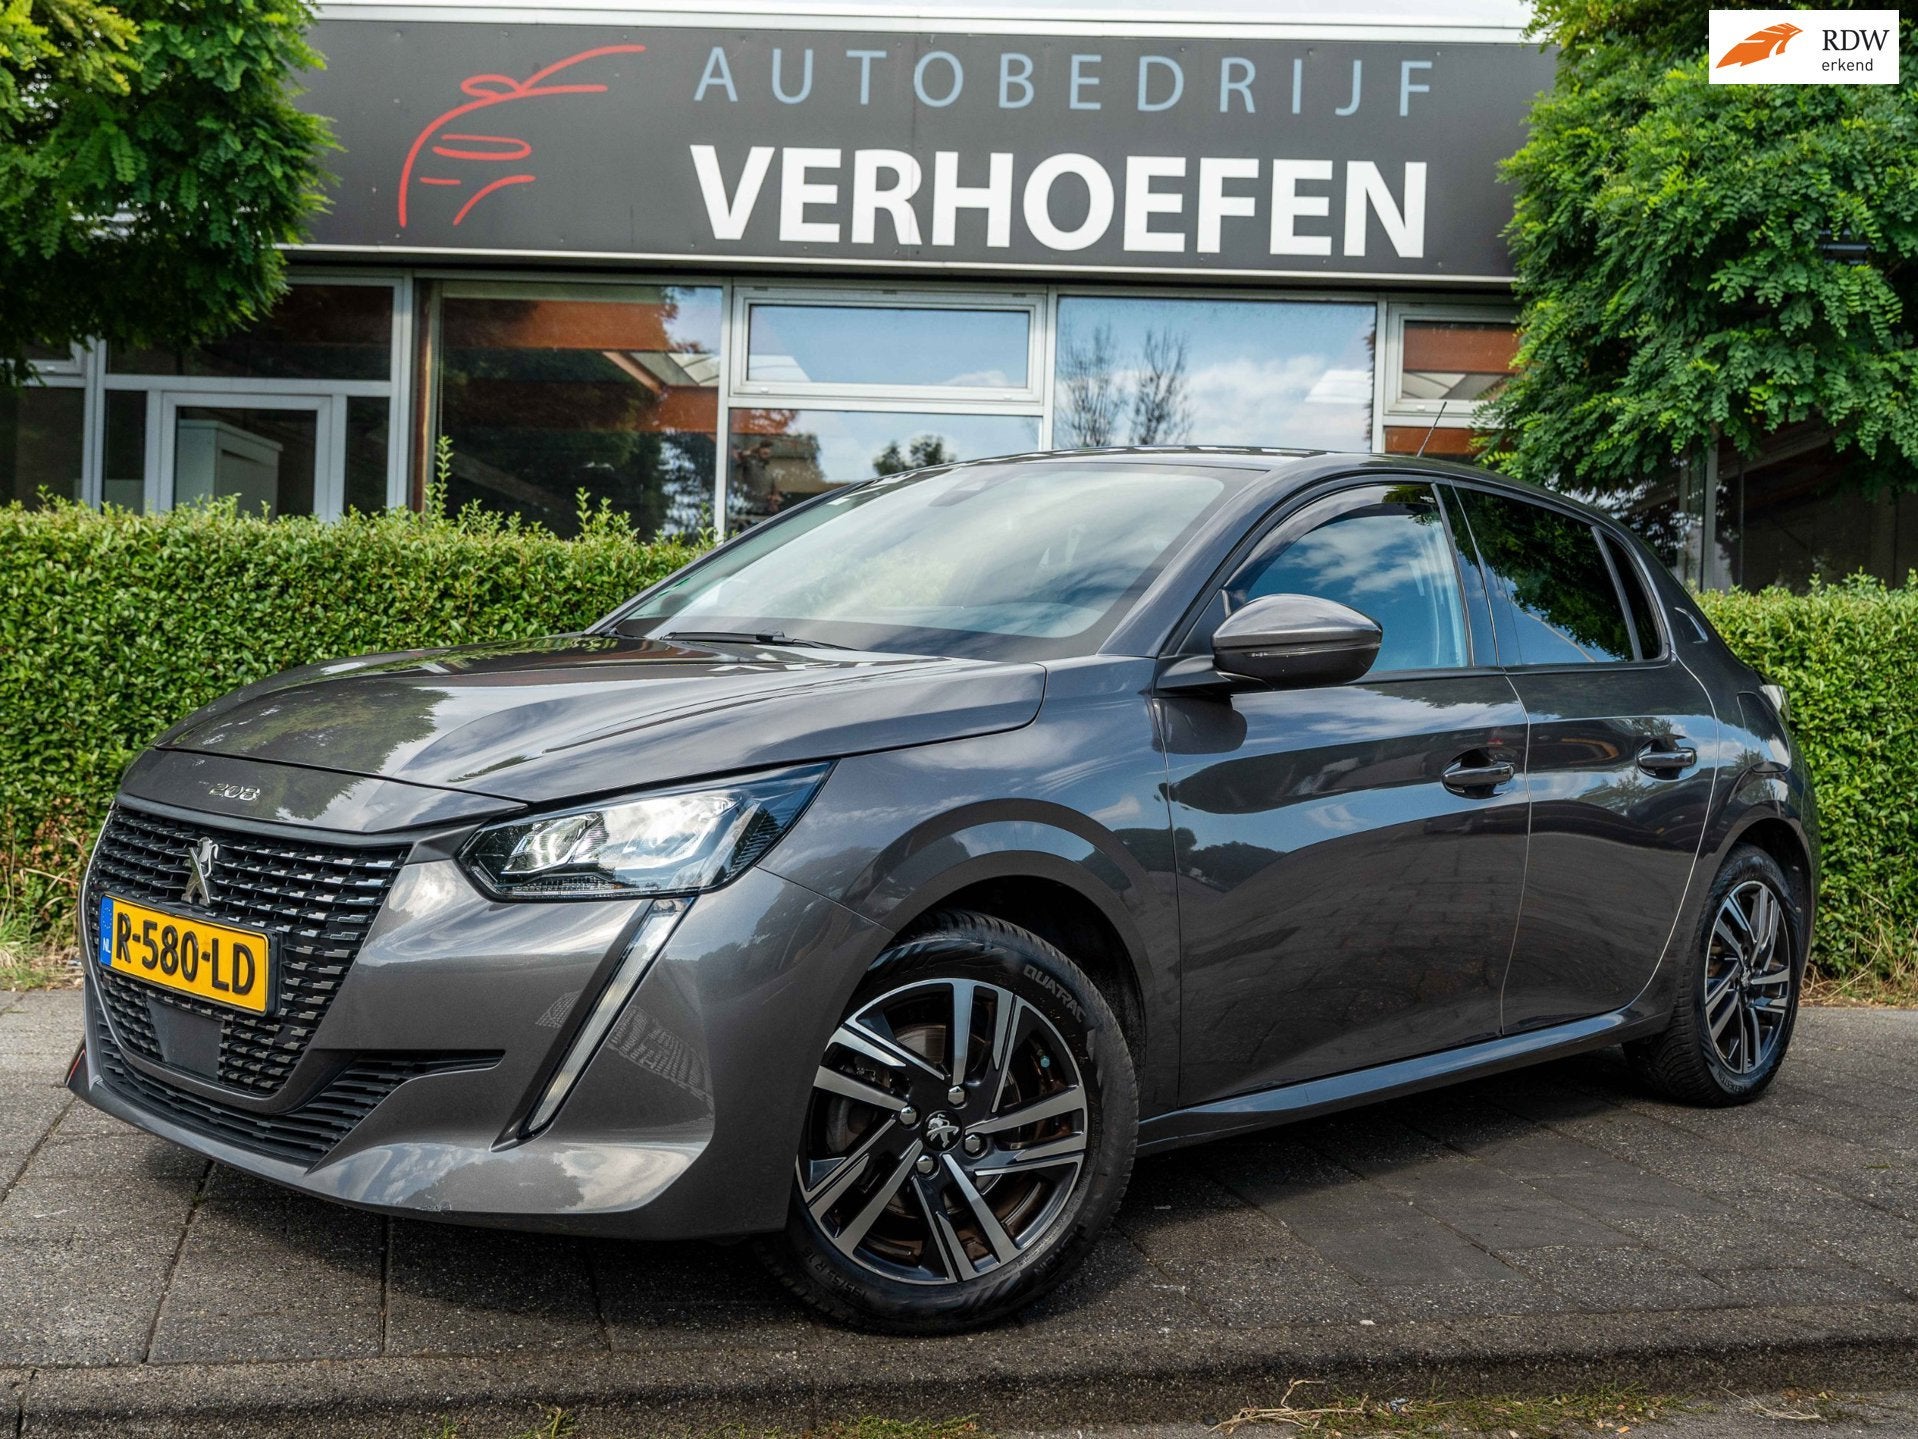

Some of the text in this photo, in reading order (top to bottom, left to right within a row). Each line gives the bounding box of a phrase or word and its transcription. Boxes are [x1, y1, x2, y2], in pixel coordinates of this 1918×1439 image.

[694, 47, 1433, 117] AUTOBEDRIJF
[690, 144, 1427, 258] VERHOEFEN
[208, 783, 260, 801] 208
[115, 911, 256, 996] R-580-LD
[1023, 964, 1087, 1023] QUATRAC
